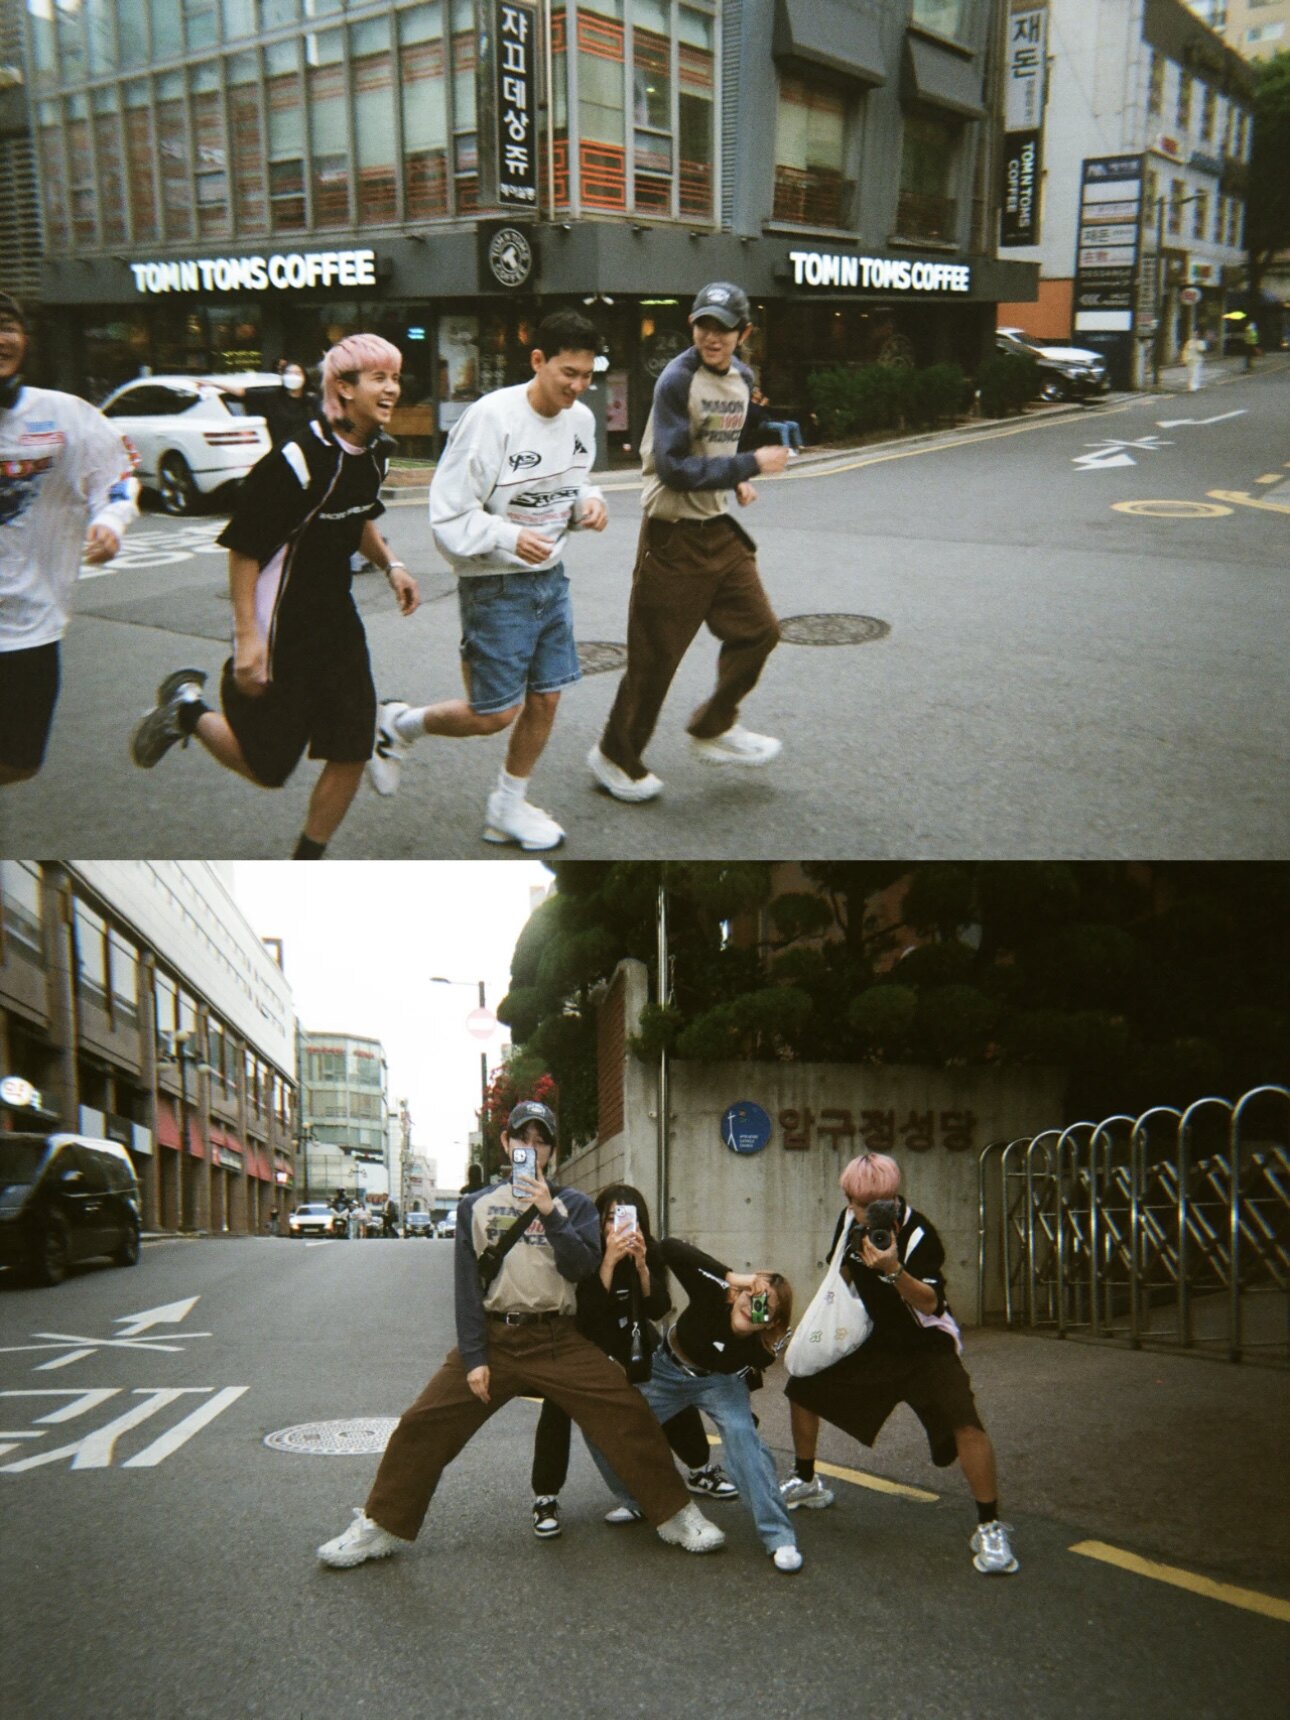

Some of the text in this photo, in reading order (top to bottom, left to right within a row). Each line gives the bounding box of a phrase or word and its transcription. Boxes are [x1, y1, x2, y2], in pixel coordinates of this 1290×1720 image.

[501, 6, 530, 176] 쟈끄데상쥬
[1006, 160, 1020, 212] COFFEE
[131, 250, 376, 293] TOM N TOMS COFFEE
[789, 252, 970, 292] TOM N TOMS COFFEE
[779, 1108, 978, 1152] 압구정성당
